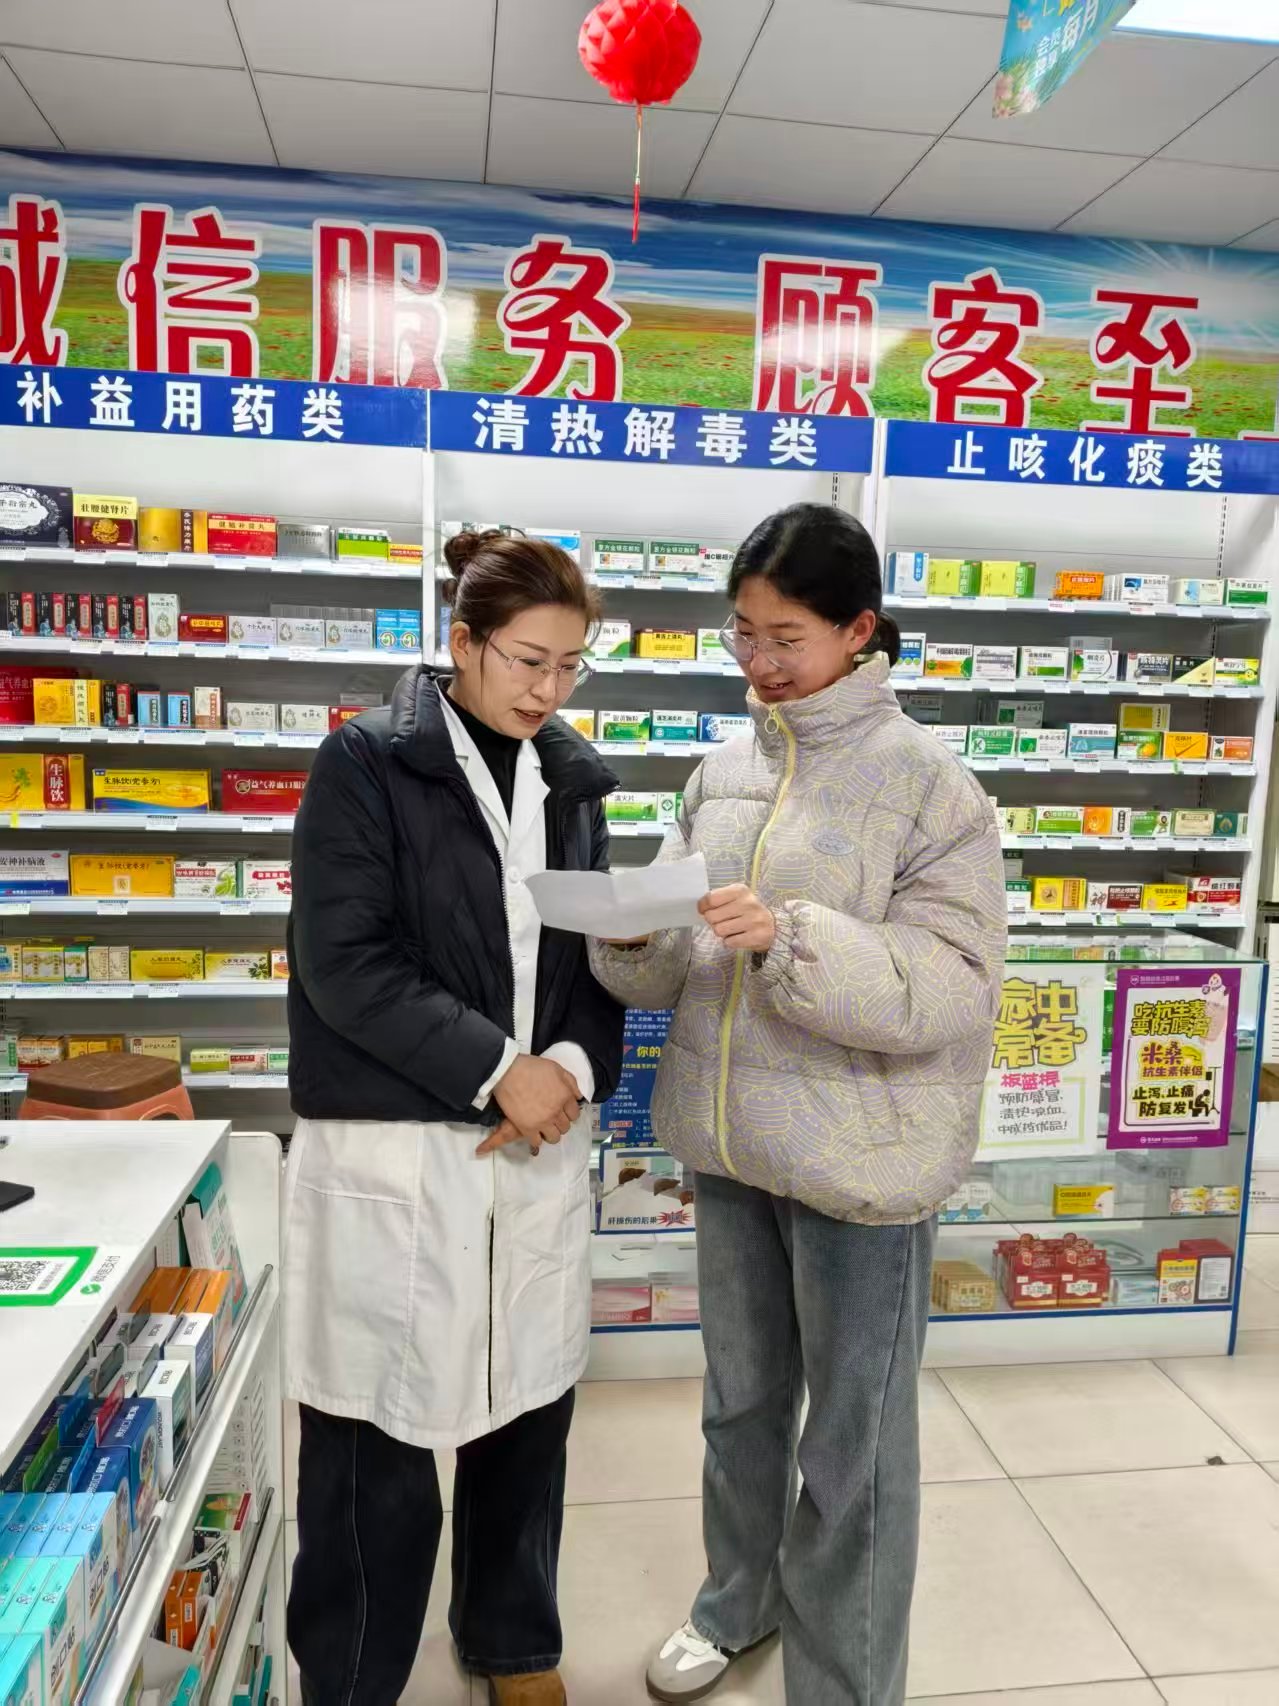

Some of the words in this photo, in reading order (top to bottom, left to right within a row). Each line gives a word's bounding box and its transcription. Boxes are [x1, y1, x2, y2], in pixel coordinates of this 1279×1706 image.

[17, 372, 345, 440] 补益用药类
[472, 398, 819, 467] 清热解毒类
[947, 431, 1225, 488] 止咳化痰类
[80, 503, 129, 515] 壮腰健肾片
[218, 520, 265, 530] 健脑补肾丸
[598, 544, 641, 555] 复方金银花颗粒
[654, 544, 697, 556] 复方金银花颗粒
[49, 763, 65, 802] 生脉饮
[1134, 1000, 1206, 1020] 吃抗生素
[1132, 1017, 1211, 1038] 要防腹泻
[636, 1046, 661, 1058] 你的
[1141, 1041, 1183, 1065] 米桑
[1142, 1065, 1203, 1078] 抗生素伴侣
[1000, 1071, 1060, 1091] 板蓝根
[1132, 1084, 1194, 1101] 止泻、止痛
[1139, 1101, 1187, 1117] 防复发
[607, 1216, 657, 1225] 肝损伤的后果
